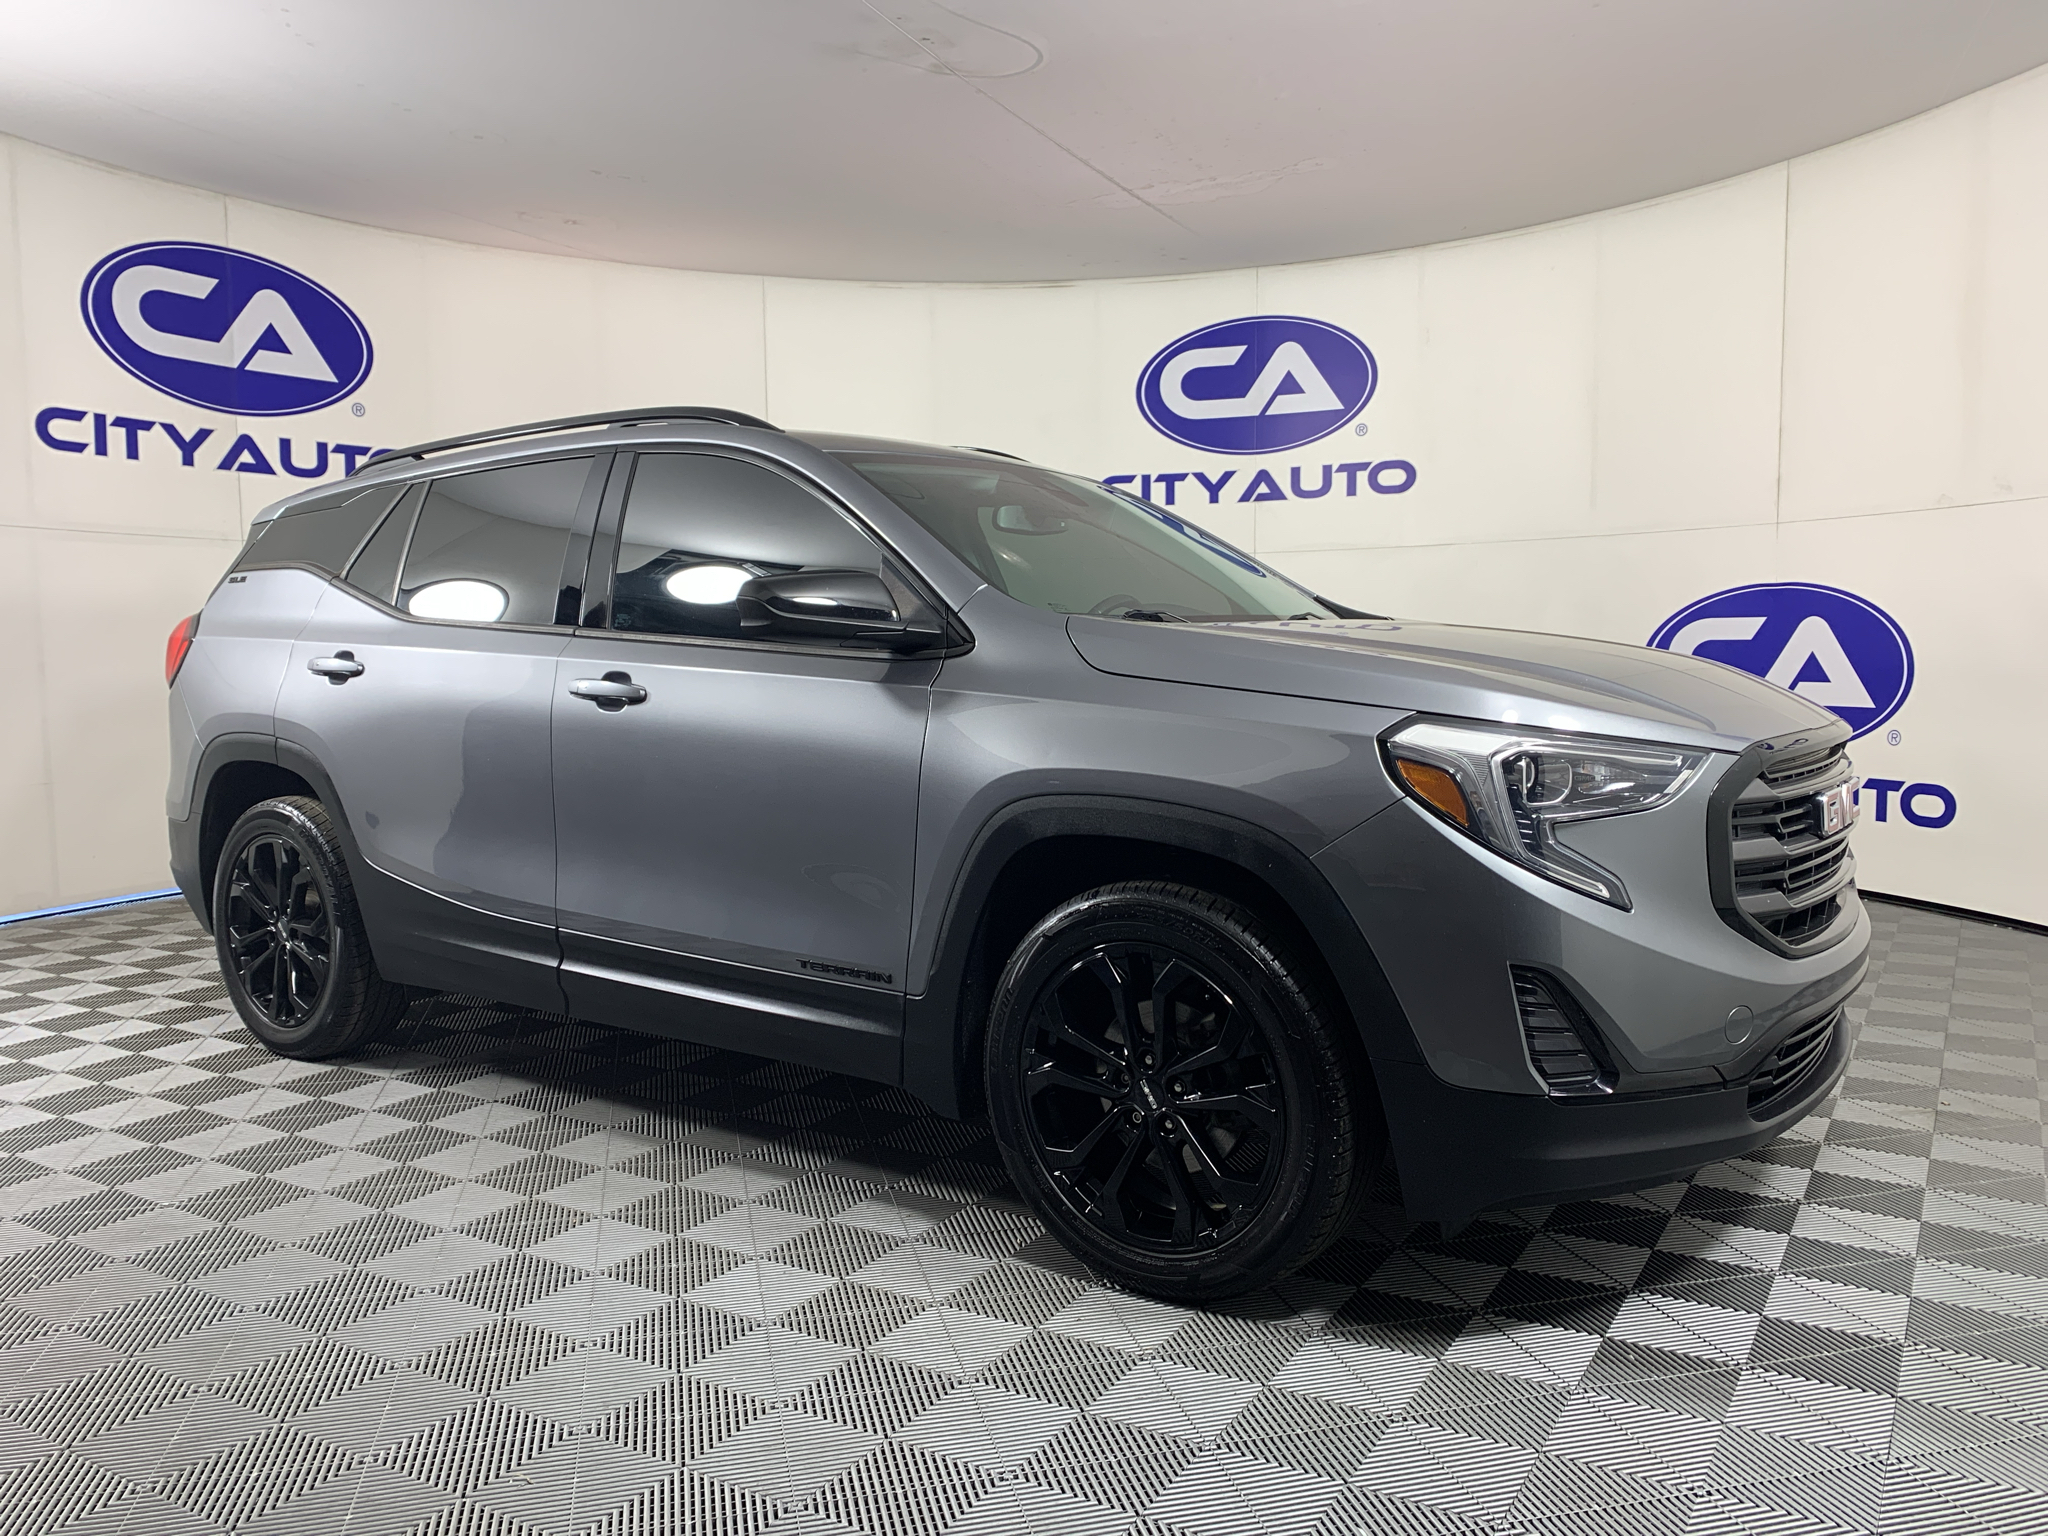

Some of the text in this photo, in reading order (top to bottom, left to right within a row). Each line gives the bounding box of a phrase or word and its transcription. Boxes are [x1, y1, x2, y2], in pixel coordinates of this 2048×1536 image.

[111, 264, 339, 383] CA
[1159, 341, 1345, 419] CA
[1823, 776, 1860, 836] GMC
[795, 957, 893, 985] TERRAIN
